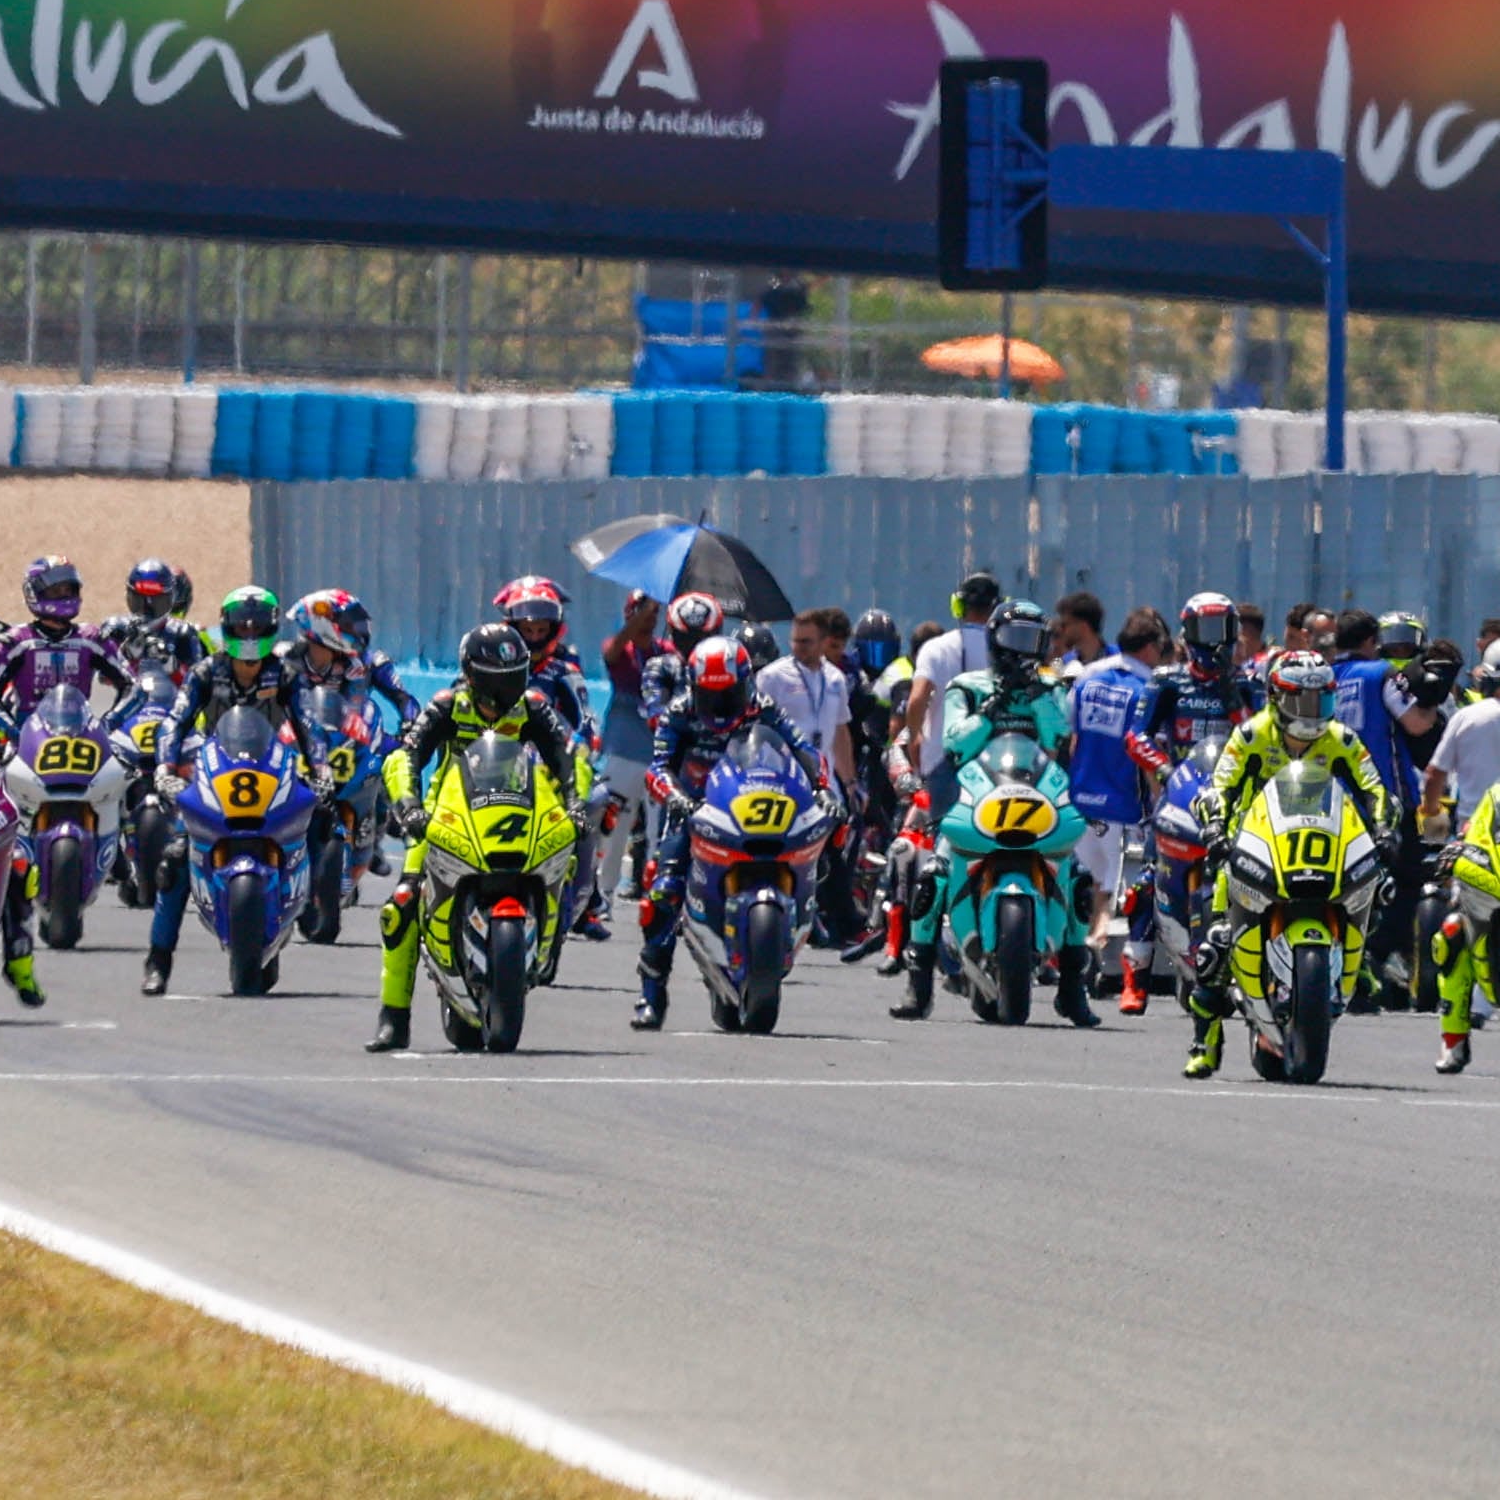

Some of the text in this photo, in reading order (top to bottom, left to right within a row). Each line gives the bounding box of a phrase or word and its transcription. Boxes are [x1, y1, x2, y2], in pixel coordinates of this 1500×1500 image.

[528, 104, 765, 139] Junta de Andalucía
[39, 739, 97, 771] 89
[229, 771, 261, 808] 8
[484, 812, 530, 844] 4
[744, 797, 788, 827] 31
[995, 797, 1045, 829] 17
[1287, 831, 1331, 867] 10
